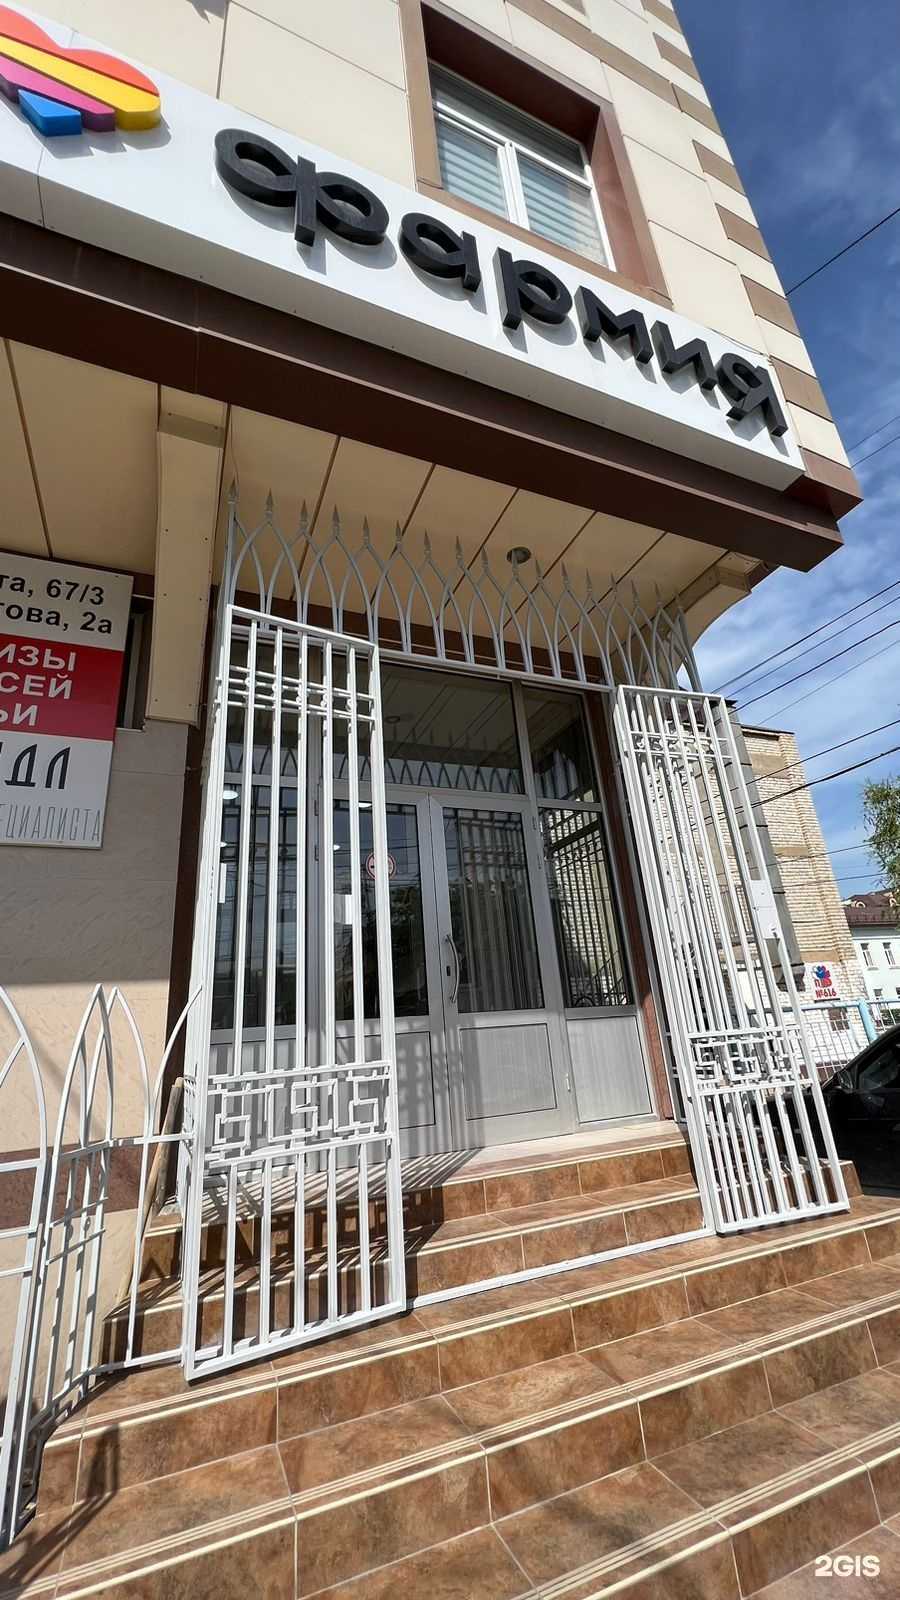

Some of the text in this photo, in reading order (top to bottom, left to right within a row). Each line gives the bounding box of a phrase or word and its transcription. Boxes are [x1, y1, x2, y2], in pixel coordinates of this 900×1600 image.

[46, 579, 104, 604] 67/3
[80, 611, 112, 634] 2а
[0, 672, 72, 700] СЕЙ
